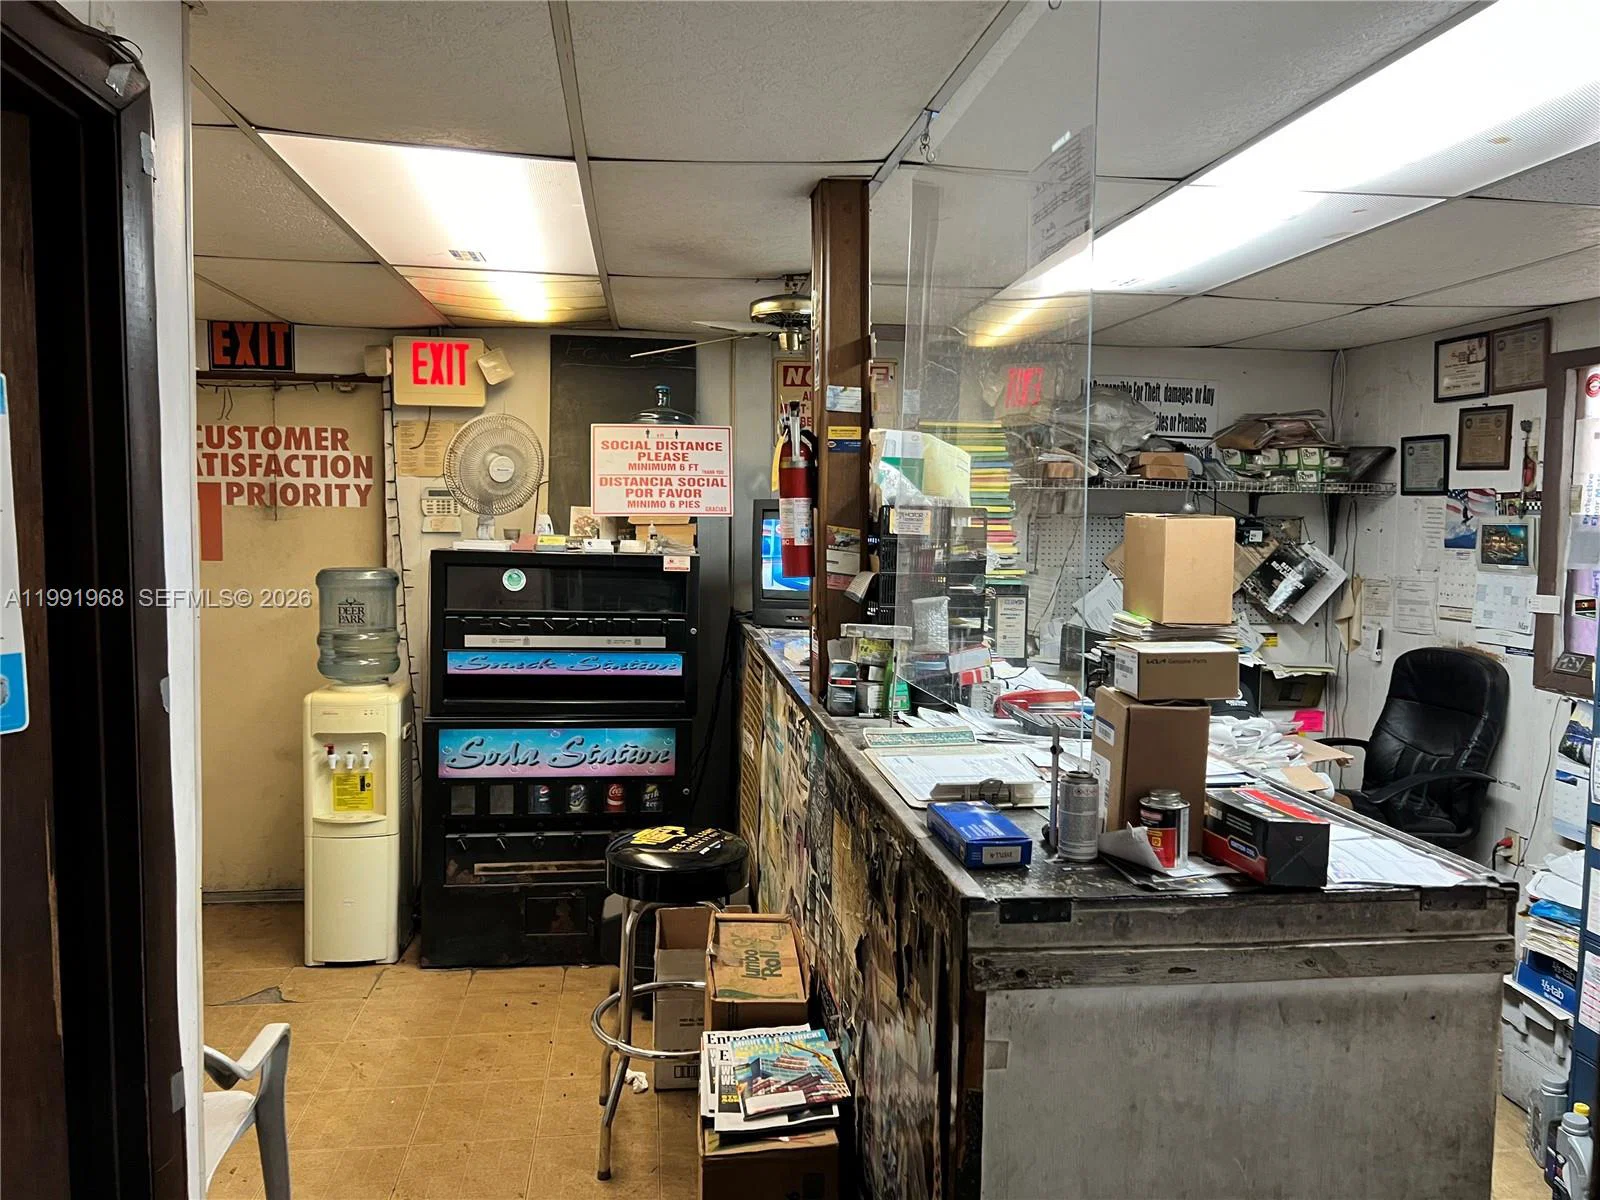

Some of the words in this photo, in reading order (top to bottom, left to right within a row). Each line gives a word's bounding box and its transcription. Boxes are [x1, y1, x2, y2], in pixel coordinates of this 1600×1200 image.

[212, 322, 289, 367] EXIT
[412, 342, 469, 386] EXIT
[1163, 383, 1194, 405] damages
[1194, 388, 1202, 403] or
[1202, 384, 1215, 406] Any
[1170, 417, 1177, 432] or
[1178, 413, 1207, 433] Premises
[600, 440, 652, 450] SOCIAL
[656, 441, 723, 452] DISTANCE
[197, 453, 373, 479] TISFACTION
[637, 452, 690, 462] PLEASE
[628, 463, 676, 472] MINIMUM
[680, 464, 685, 472] 6
[599, 476, 673, 487] DISTANCIA
[678, 478, 728, 488] SOCIAL
[226, 482, 373, 507] PRIORITY
[625, 488, 654, 498] POR
[658, 488, 702, 498] FAVOR
[627, 500, 666, 508] MINIMO
[670, 500, 676, 508] 6
[679, 500, 701, 508] PIES
[338, 606, 364, 616] DEER
[338, 614, 366, 624] PARK
[454, 656, 558, 672] Snack
[566, 656, 678, 672] Station
[446, 736, 541, 769] Soda
[548, 736, 671, 769] Station
[741, 950, 768, 980] Jumbo
[760, 950, 782, 978] Roll
